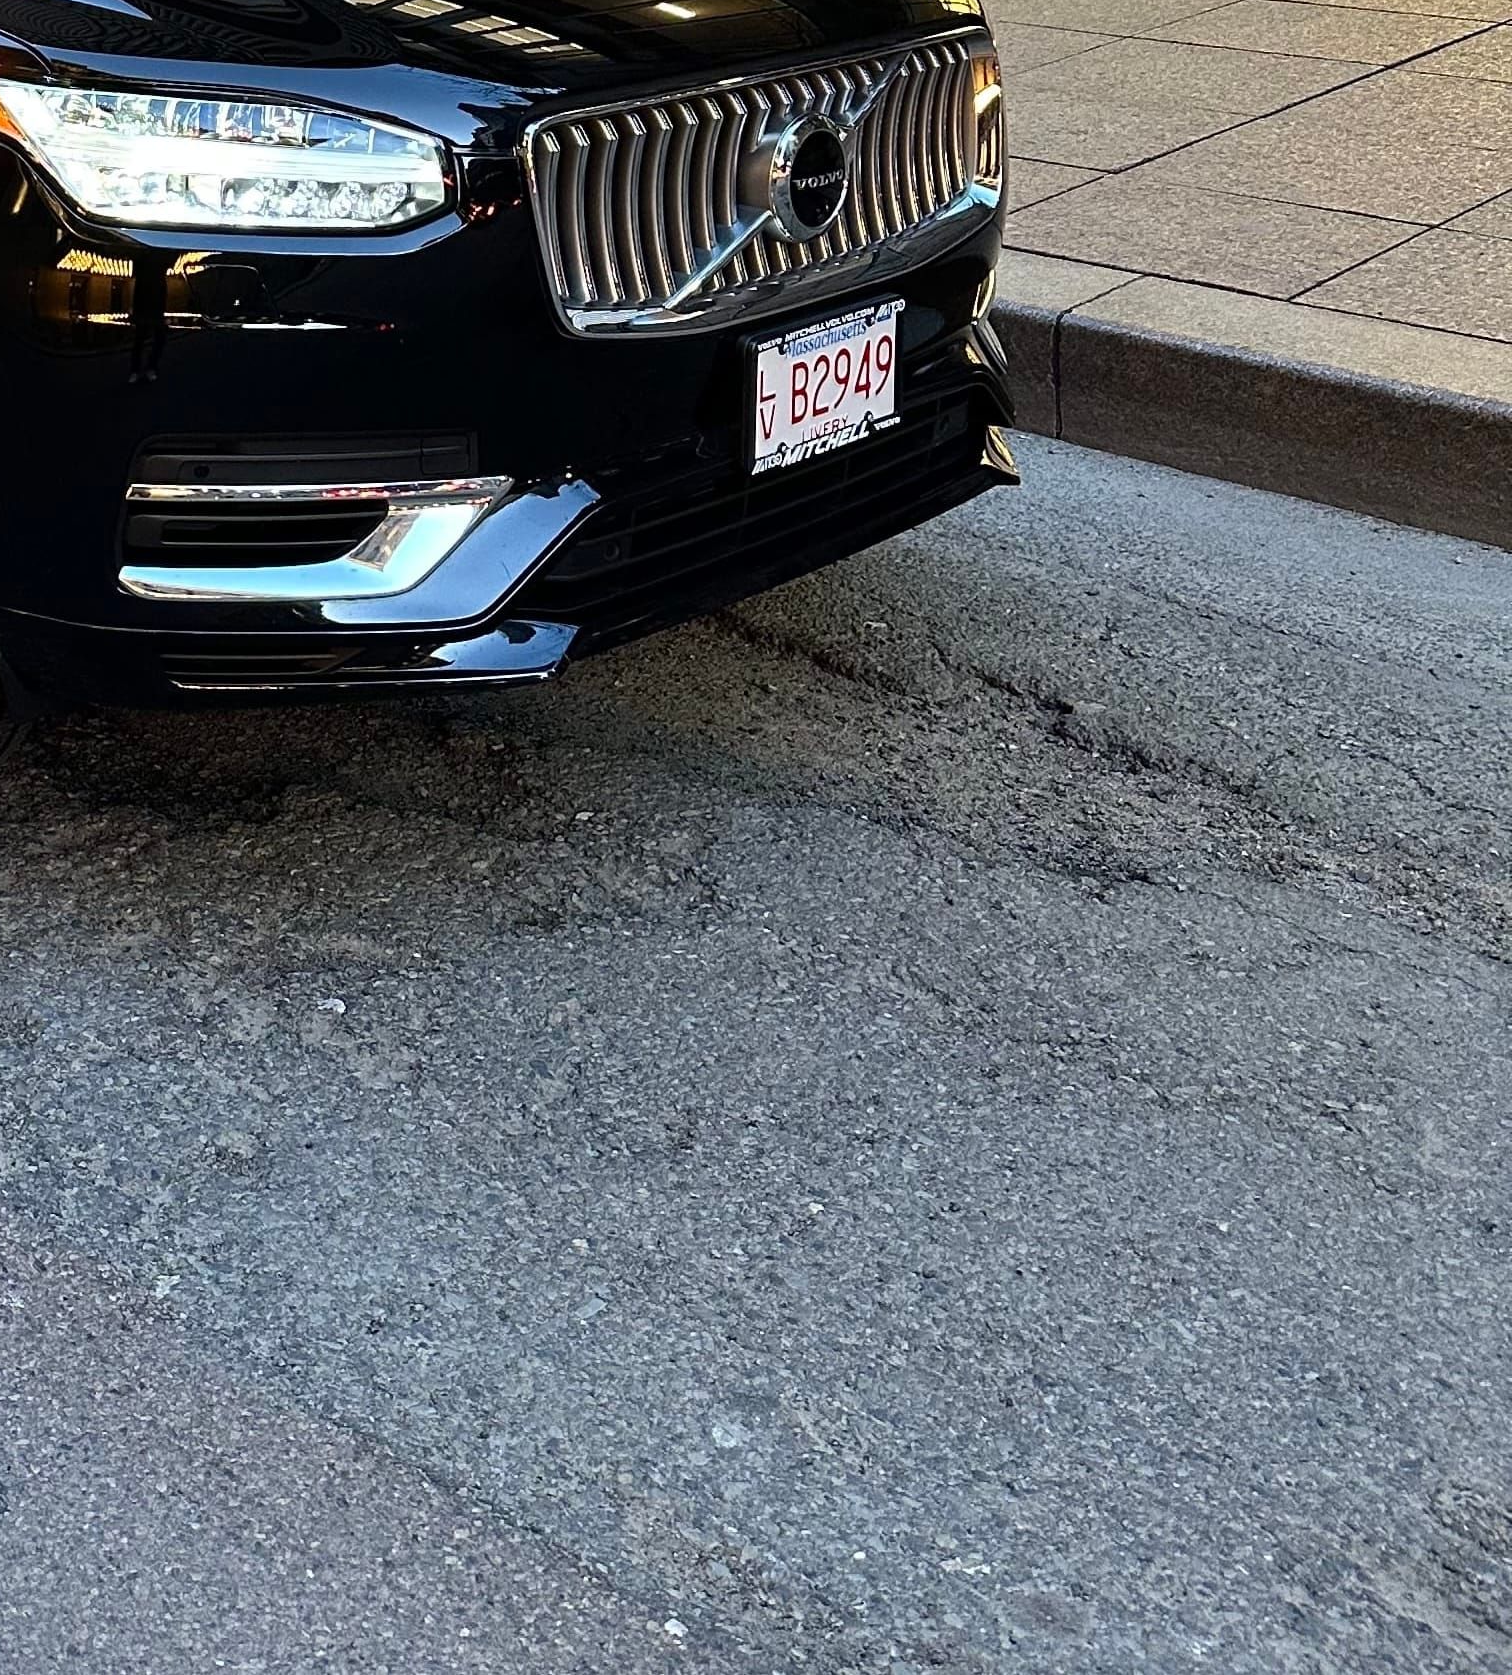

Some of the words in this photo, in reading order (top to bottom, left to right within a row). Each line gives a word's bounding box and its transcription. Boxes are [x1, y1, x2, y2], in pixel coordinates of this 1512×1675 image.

[792, 168, 844, 190] VOLVO
[785, 319, 868, 358] Massachusetts
[791, 334, 894, 425] B2949
[781, 420, 870, 468] MITCHELL
[801, 414, 849, 442] LIVERY
